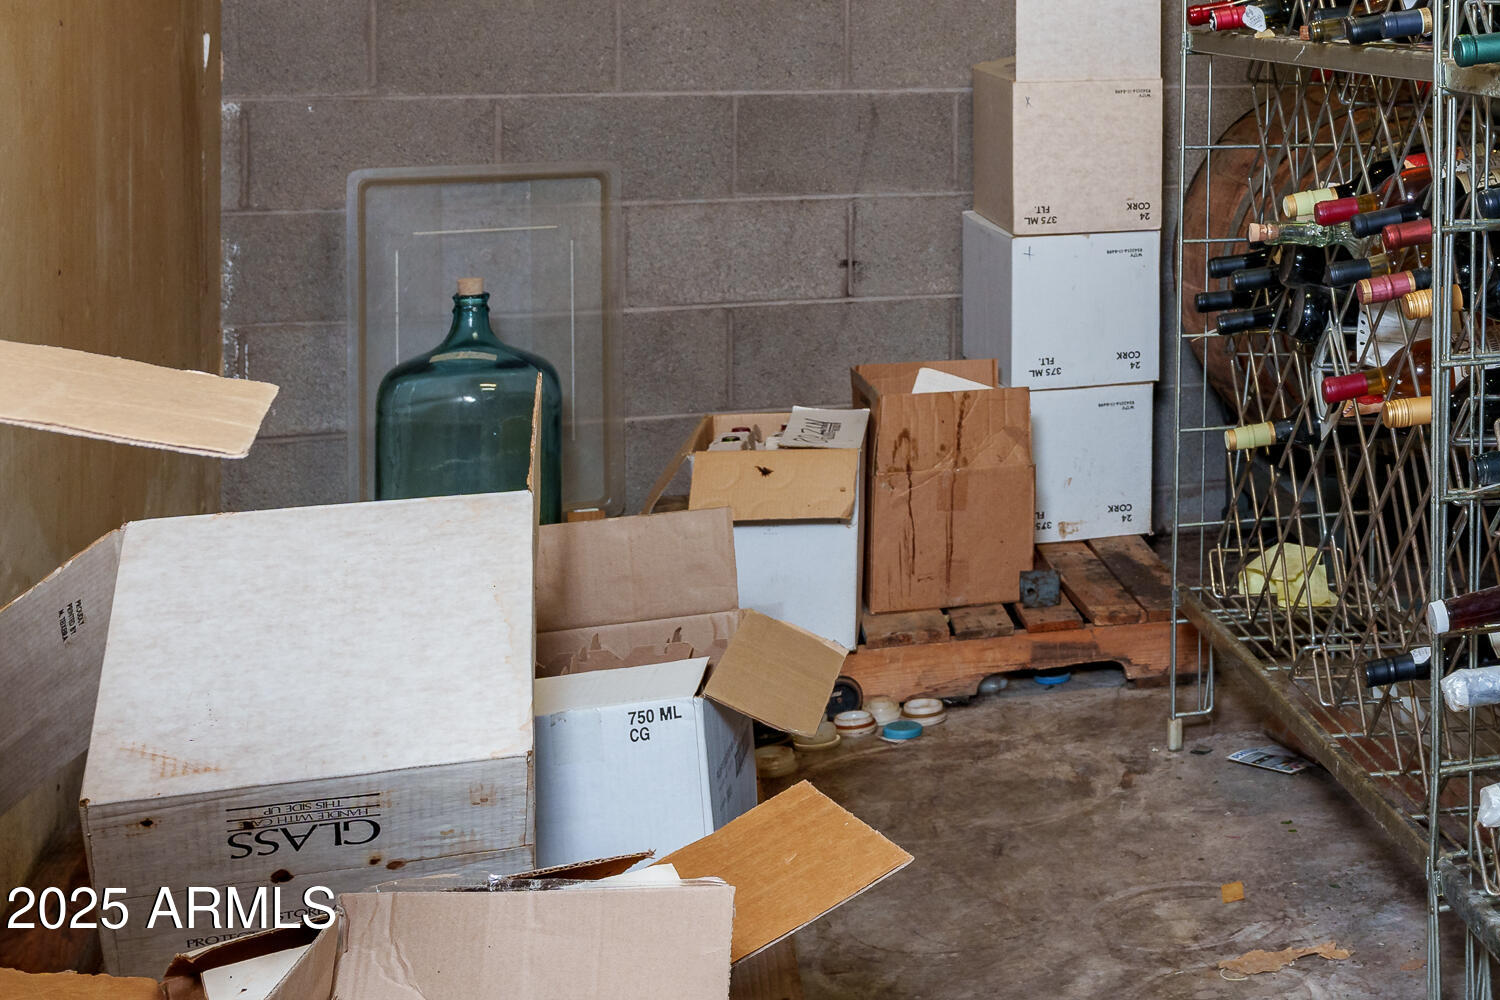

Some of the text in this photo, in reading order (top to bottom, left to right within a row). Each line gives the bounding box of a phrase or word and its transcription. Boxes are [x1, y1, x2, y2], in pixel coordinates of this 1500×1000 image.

[1126, 202, 1151, 211] CORK
[1041, 216, 1058, 225] 375
[1140, 212, 1151, 221] 24
[1116, 350, 1141, 360] CORK
[1129, 361, 1141, 369] 24
[1045, 367, 1062, 376] 375
[1107, 503, 1133, 513] CORK
[1121, 514, 1133, 522] 24
[1035, 521, 1052, 530] 375
[628, 705, 682, 725] 750 ML
[629, 727, 651, 743] CG
[263, 799, 343, 816] THIS SIDE UP
[276, 812, 313, 824] WITH
[316, 808, 369, 819] HANDLE
[227, 819, 381, 860] GLASS
